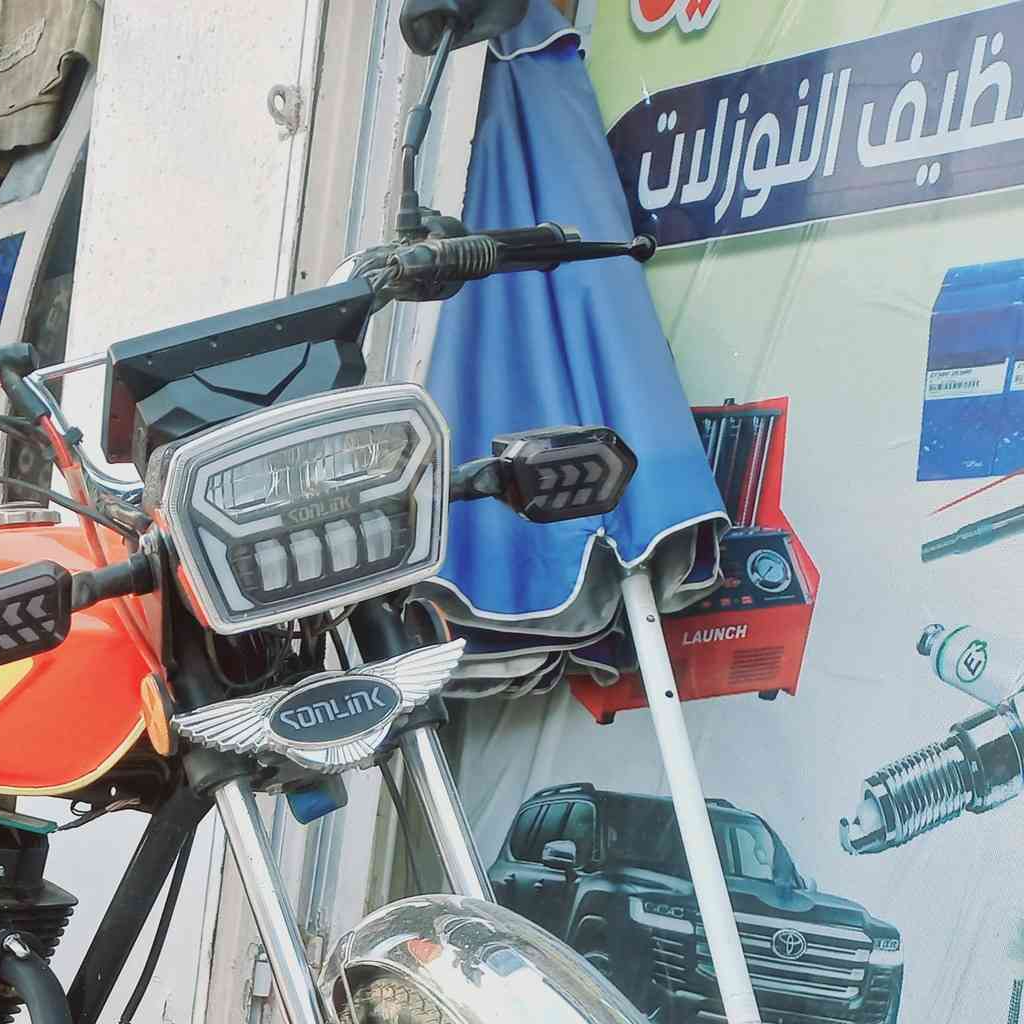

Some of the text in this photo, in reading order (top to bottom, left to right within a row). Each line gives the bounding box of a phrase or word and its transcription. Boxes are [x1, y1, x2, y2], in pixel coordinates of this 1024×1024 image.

[637, 31, 1024, 225] ظيف النوزلات
[682, 624, 748, 645] LAUNCH
[279, 686, 387, 731] SONLINK
